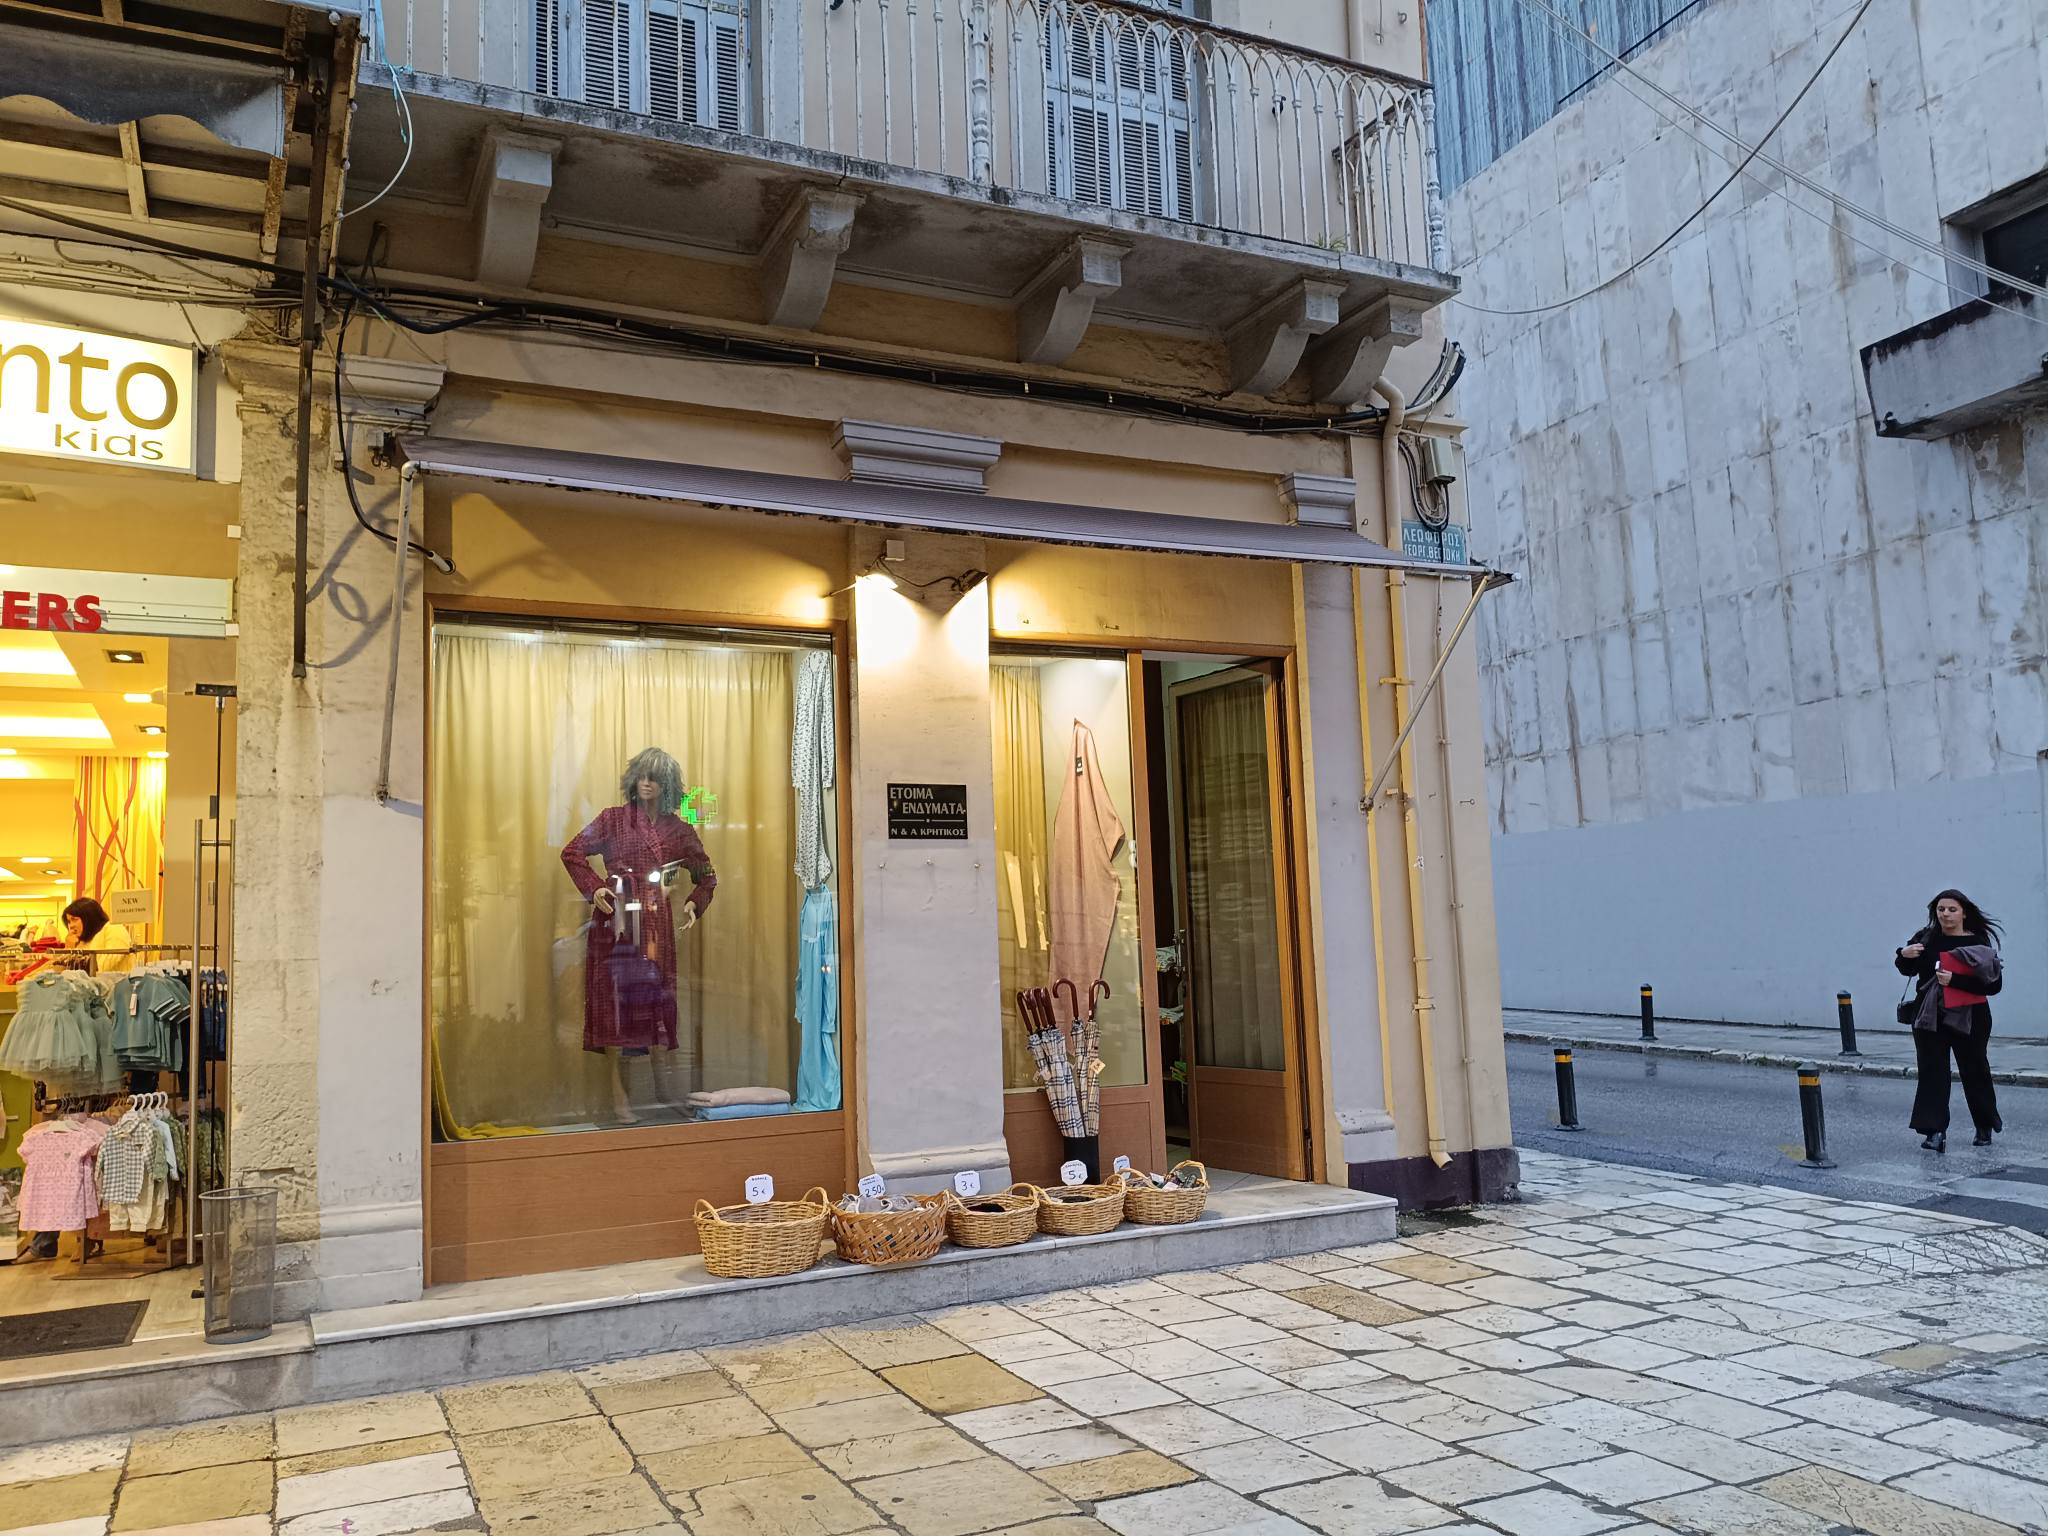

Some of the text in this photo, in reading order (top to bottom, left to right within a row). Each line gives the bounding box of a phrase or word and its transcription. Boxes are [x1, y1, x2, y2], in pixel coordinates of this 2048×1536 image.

[54, 423, 164, 461] kids
[1, 590, 102, 634] ERS
[889, 787, 934, 800] ΕΤΟΙΜΑ
[902, 801, 964, 815] ΕΝΔΥΜΑΤΑ
[900, 828, 908, 836] &
[920, 828, 967, 836] ΚΡΗΤΙΚΟΣ
[122, 897, 138, 905] NEW
